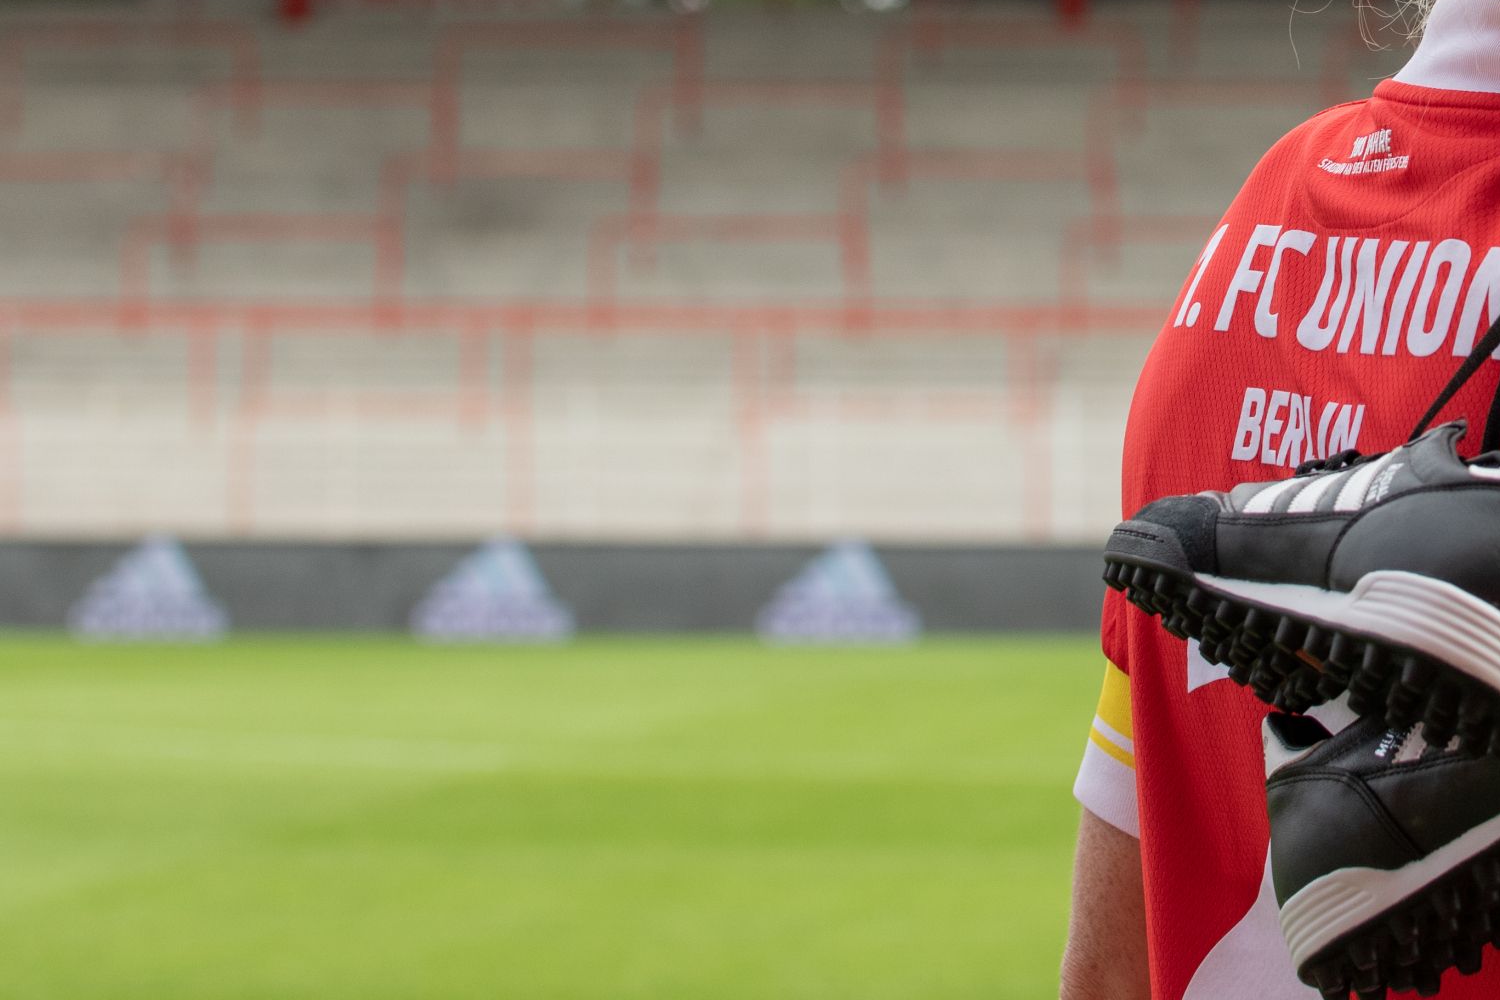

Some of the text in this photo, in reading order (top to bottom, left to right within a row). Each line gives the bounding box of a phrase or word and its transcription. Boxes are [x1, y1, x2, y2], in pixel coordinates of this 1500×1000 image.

[1174, 223, 1229, 328] 1.
[1213, 224, 1317, 338] FC
[1231, 387, 1366, 469] BERLIN
